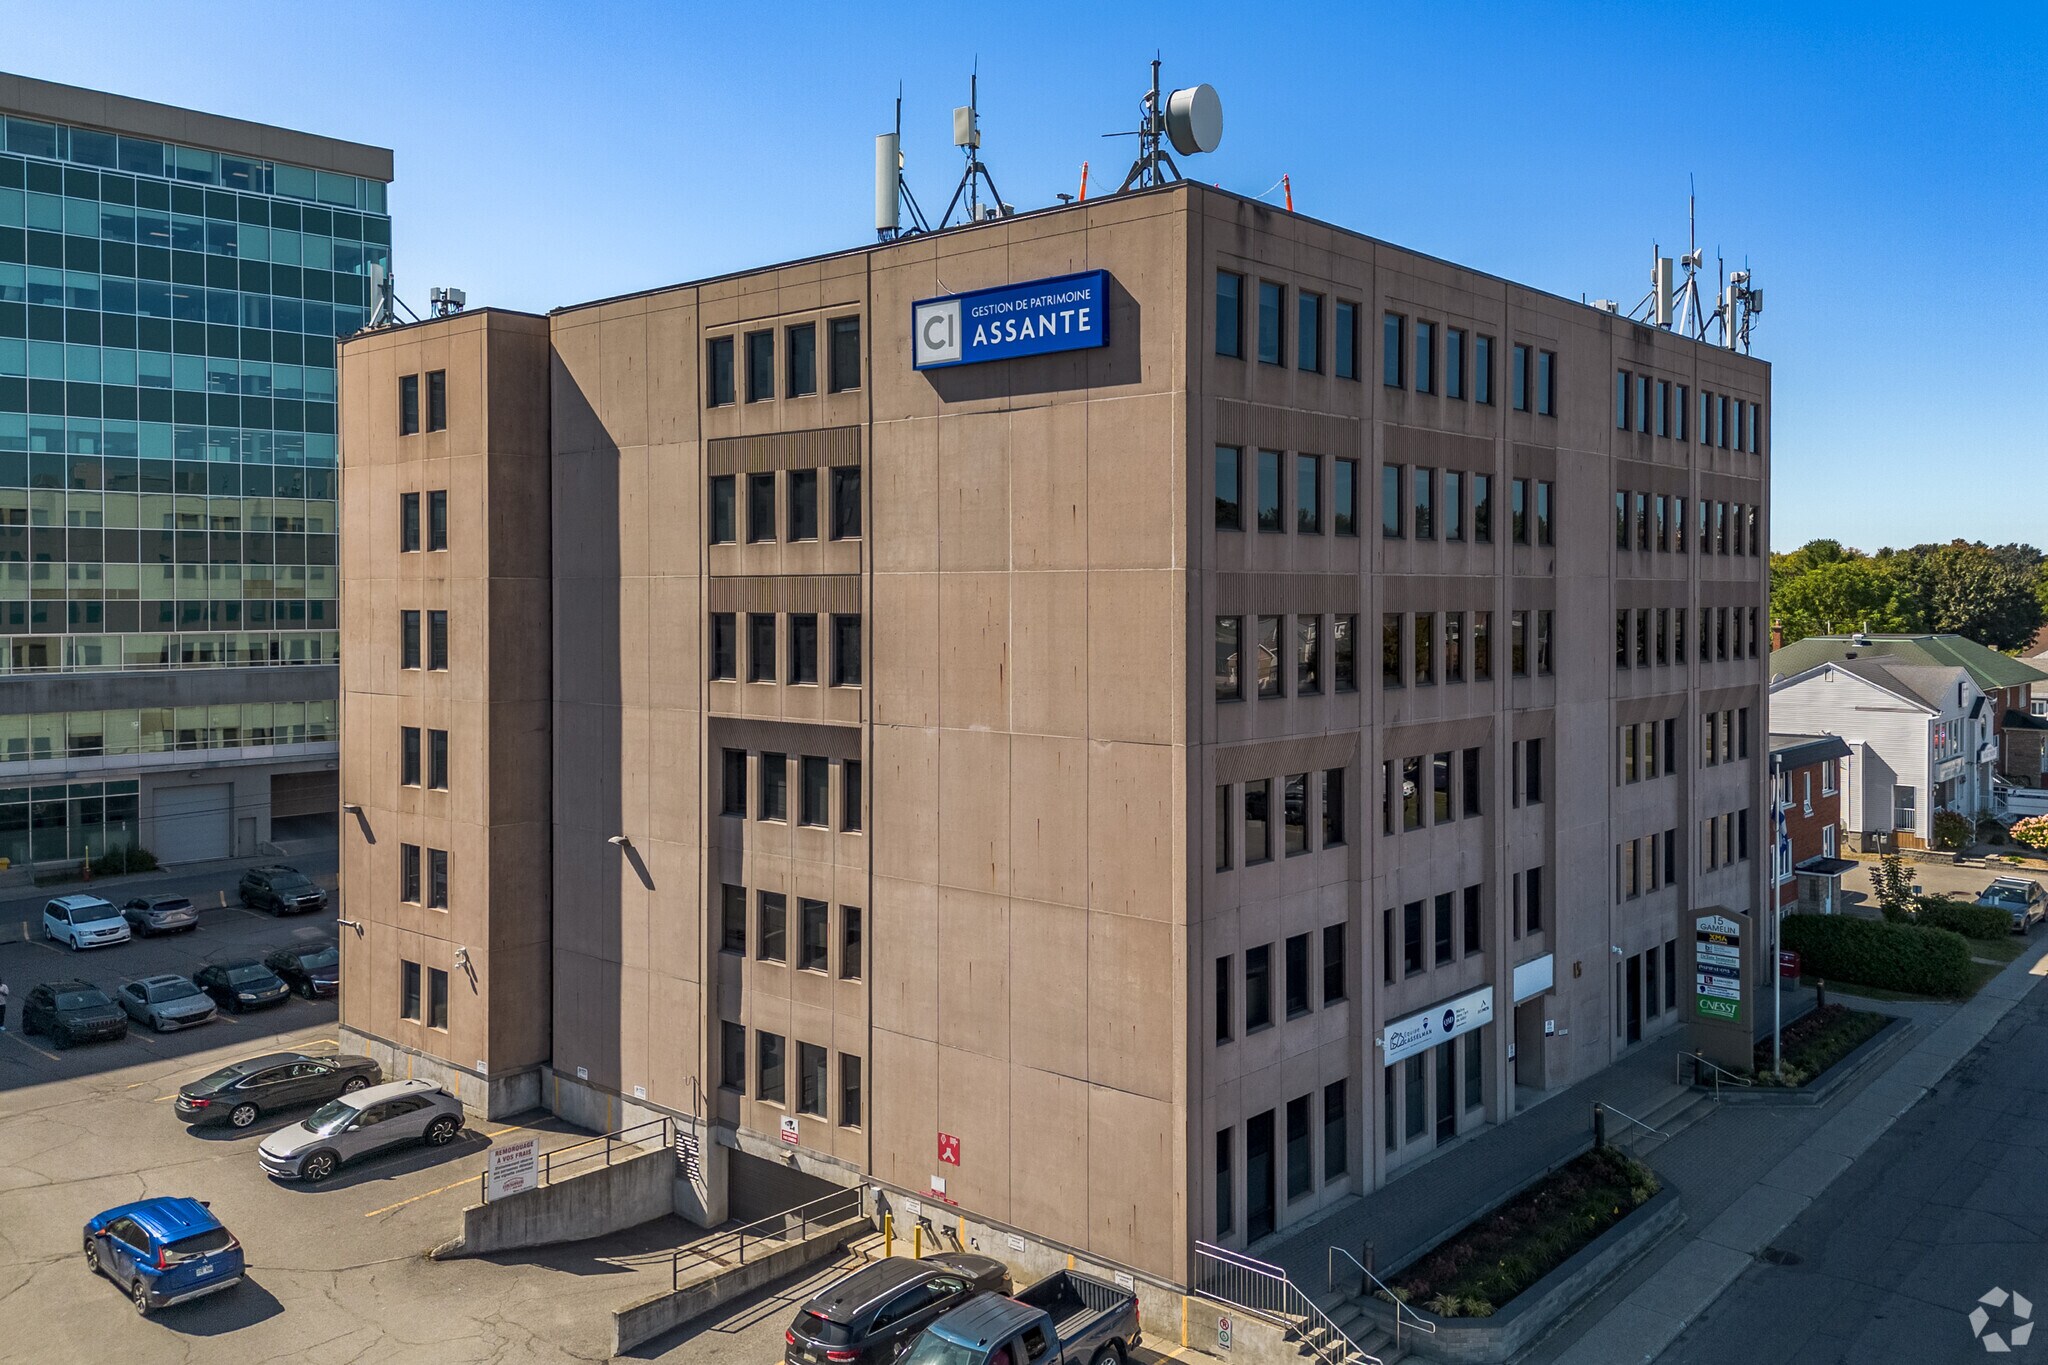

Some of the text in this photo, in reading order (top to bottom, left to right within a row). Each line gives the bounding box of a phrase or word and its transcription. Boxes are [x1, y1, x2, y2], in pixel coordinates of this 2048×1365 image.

[971, 288, 1091, 318] GESTION DE PATRIMOINE
[923, 313, 954, 350] CI
[972, 307, 1091, 347] ASSANTE
[1700, 923, 1736, 934] GAMELIN
[1713, 916, 1724, 925] 15
[1699, 999, 1737, 1013] CNESST
